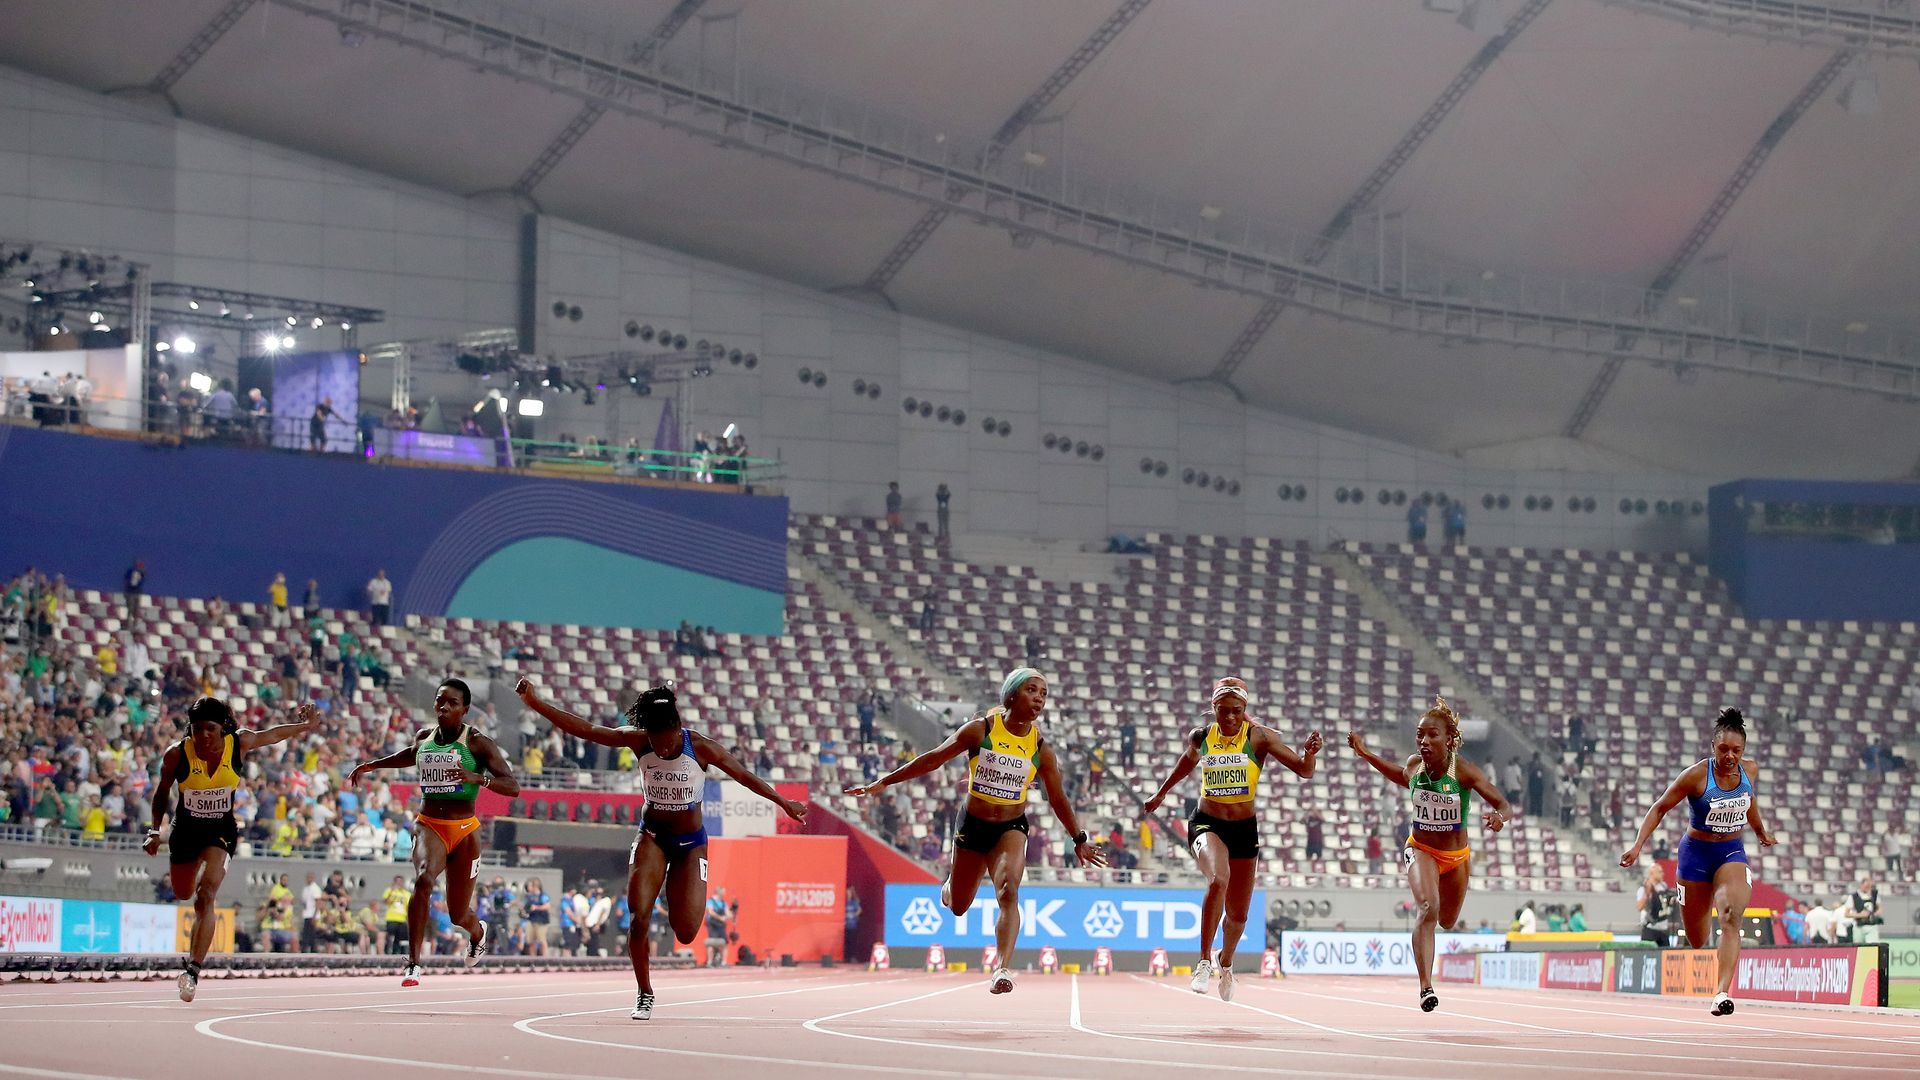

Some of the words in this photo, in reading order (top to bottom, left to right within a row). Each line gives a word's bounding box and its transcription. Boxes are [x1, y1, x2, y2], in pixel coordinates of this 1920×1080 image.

[433, 754, 454, 763] QNB
[998, 756, 1023, 769] QNB
[1218, 756, 1242, 765] QNB
[665, 772, 689, 782] QNB
[1204, 769, 1247, 786] THOMPSON
[203, 788, 225, 797] QNB
[647, 785, 694, 800] ASHER-SMITH
[978, 785, 1015, 799] DOHA2019
[186, 798, 195, 808] J.
[197, 797, 228, 811] SMITH
[1431, 795, 1454, 804] QNB
[1728, 799, 1746, 809] QNB
[653, 803, 689, 811] DOHA2019
[1415, 805, 1429, 820] TA
[1433, 808, 1458, 821] LOU
[1708, 810, 1746, 823] DANIELS
[1419, 823, 1454, 832] DOHA2019
[1, 900, 55, 952] ExxonMobil
[874, 948, 886, 962] 9
[930, 948, 942, 964] 8
[984, 950, 997, 965] 7
[1042, 951, 1054, 966] 6
[1098, 952, 1109, 966] 5
[1153, 952, 1165, 966] 4
[1313, 941, 1358, 965] QNB
[1265, 956, 1277, 969] 2
